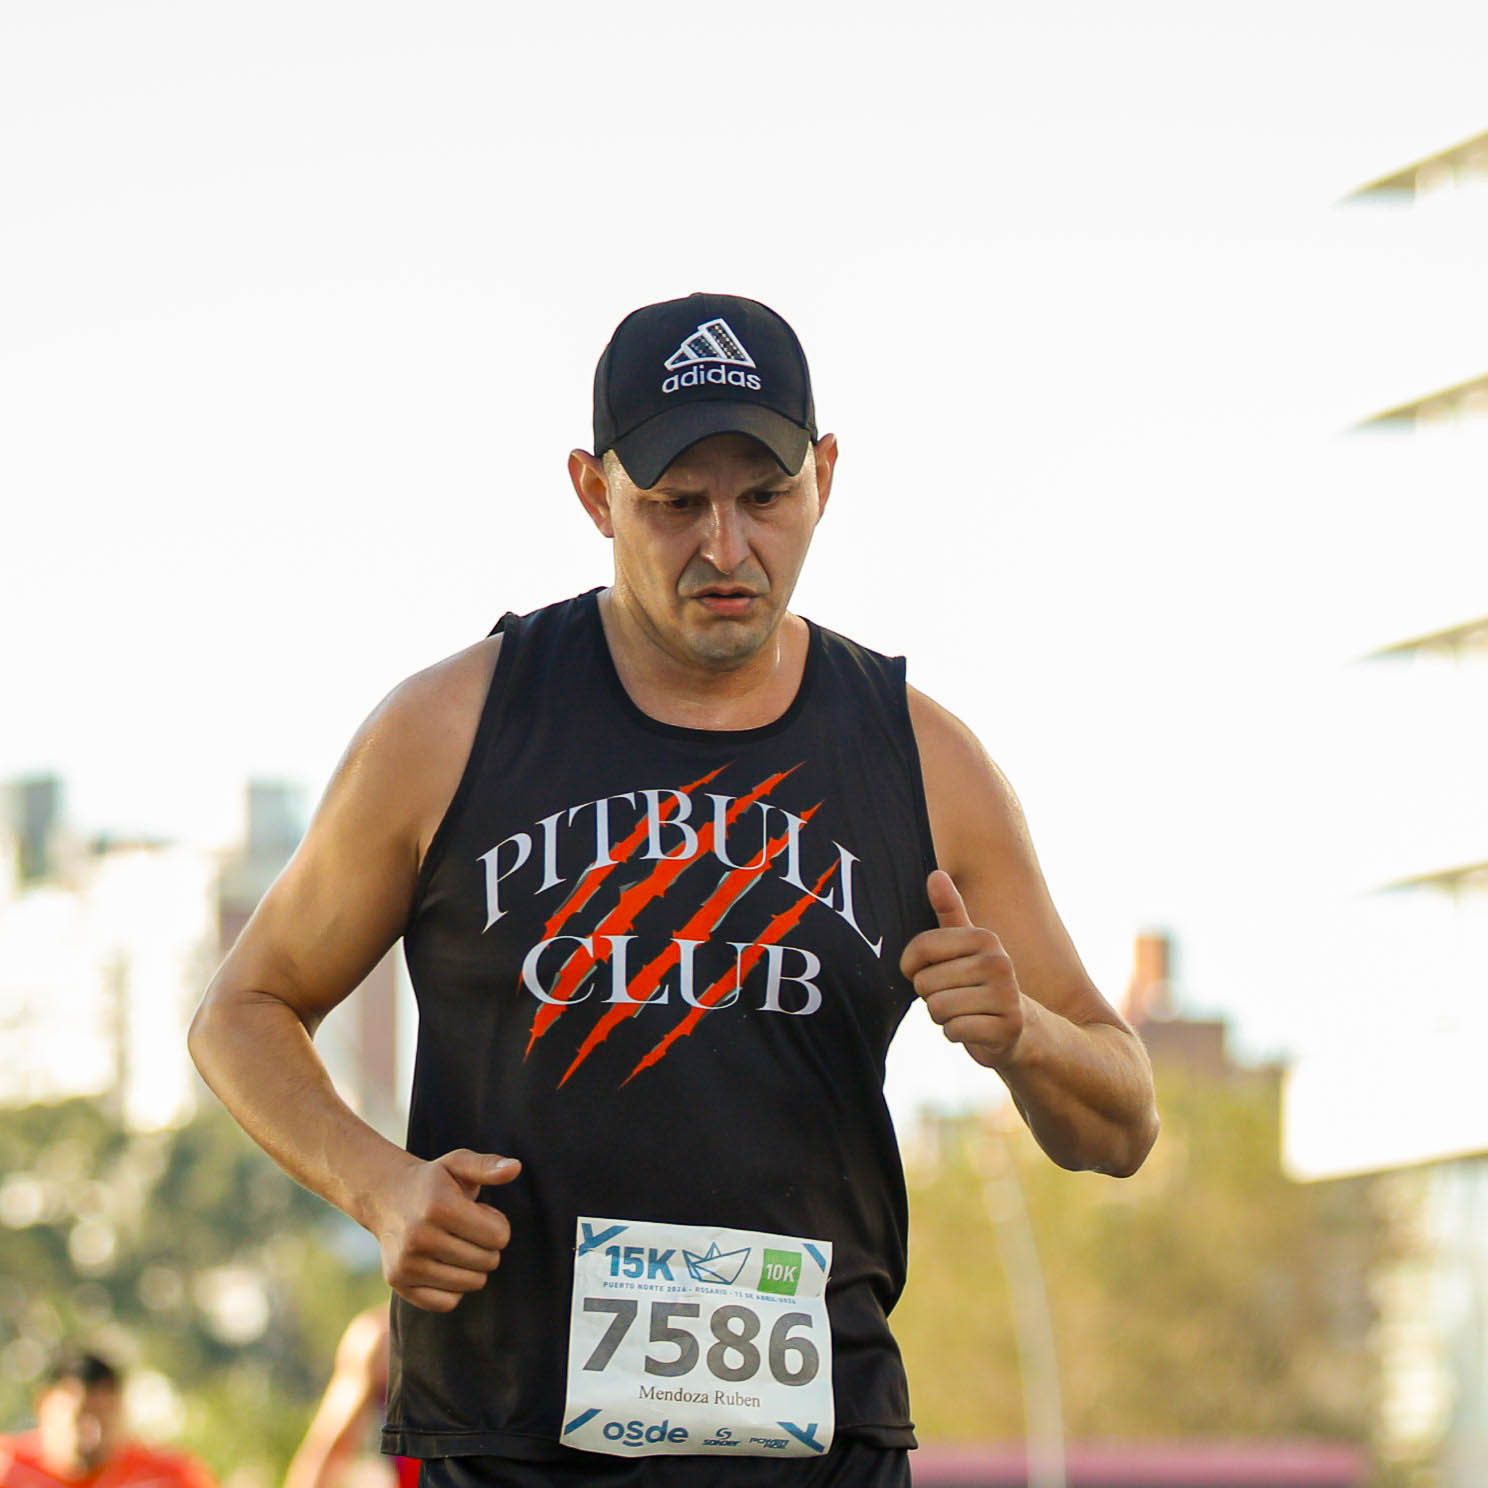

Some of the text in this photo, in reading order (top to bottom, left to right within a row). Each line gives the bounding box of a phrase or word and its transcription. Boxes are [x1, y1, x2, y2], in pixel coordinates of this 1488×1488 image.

[662, 364, 761, 393] adidas
[475, 788, 883, 958] PITBULL
[521, 934, 823, 1016] CLUB
[604, 1245, 677, 1282] 15K
[765, 1262, 799, 1283] 10K
[603, 1281, 635, 1289] PUERTO
[637, 1283, 664, 1292] NORTE
[582, 1297, 821, 1387] 7586
[639, 1384, 761, 1408] Mendoza Ruben
[602, 1419, 689, 1447] osde
